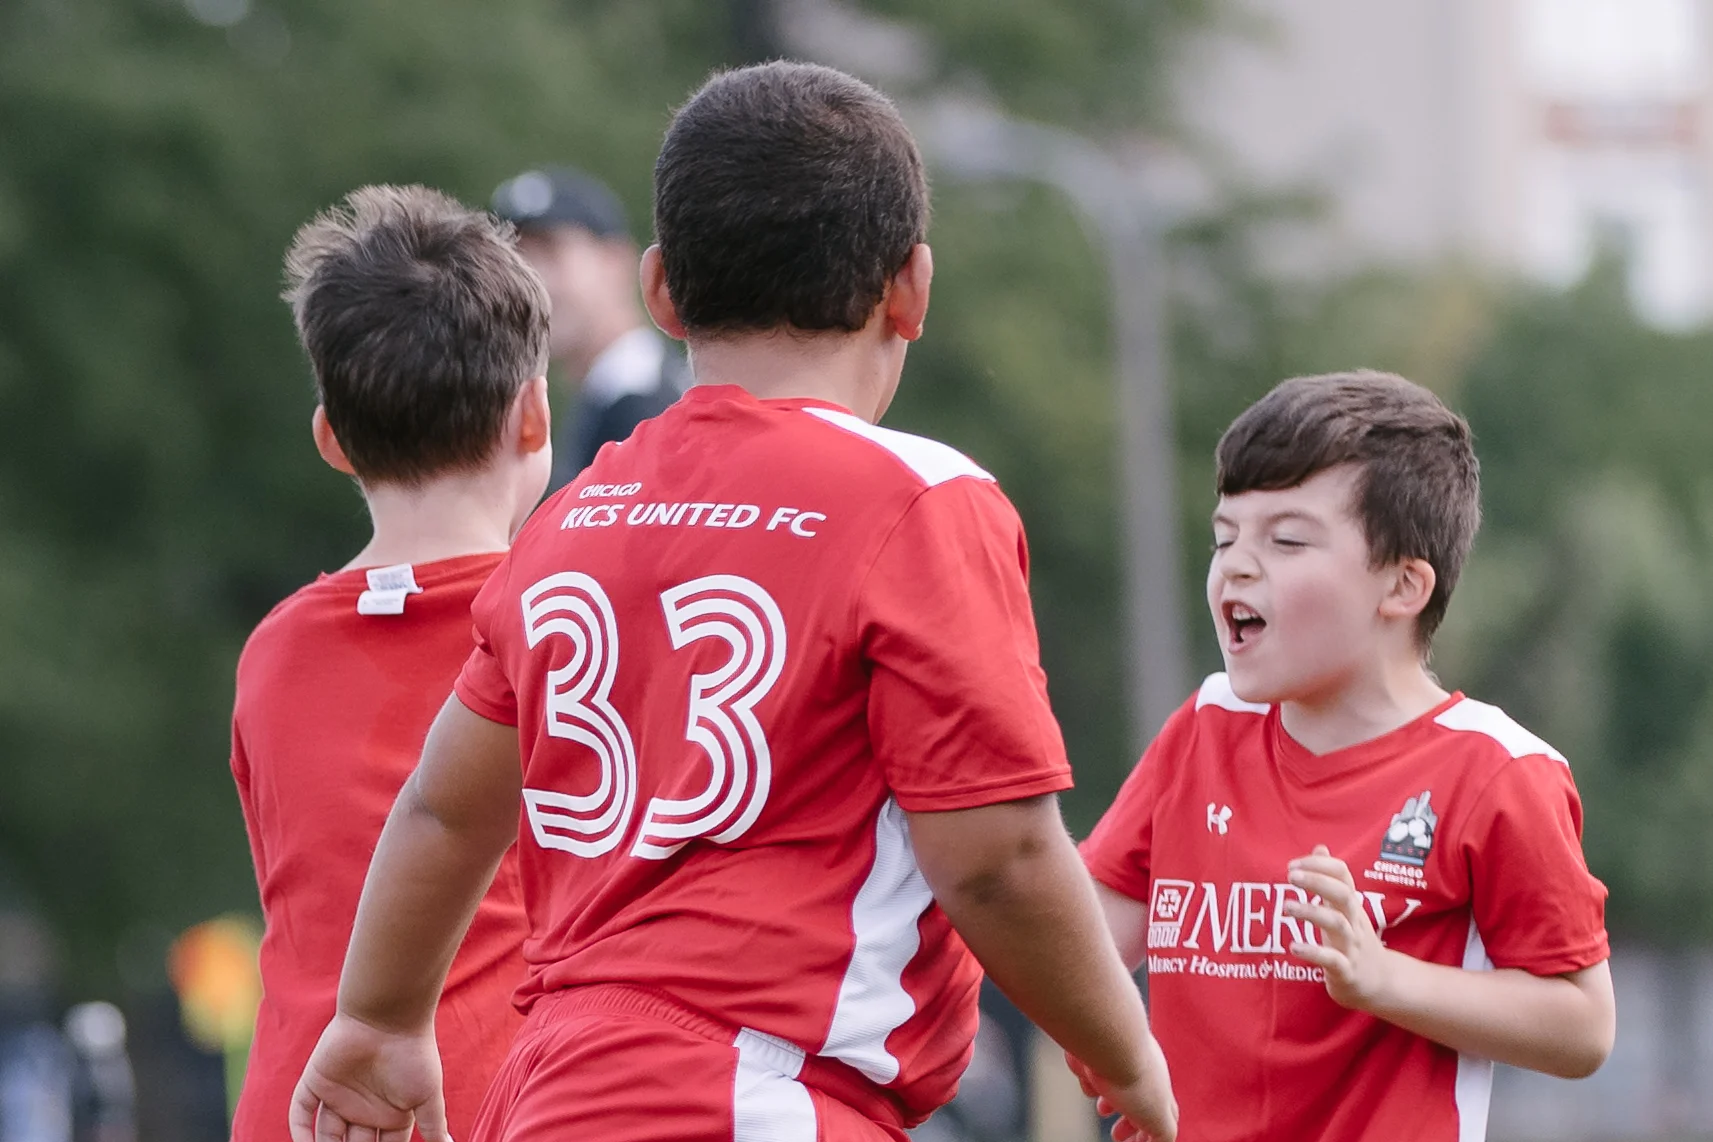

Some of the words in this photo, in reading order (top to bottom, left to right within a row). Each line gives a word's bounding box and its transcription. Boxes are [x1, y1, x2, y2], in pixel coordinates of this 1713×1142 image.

[579, 482, 642, 499] CHICAGO
[560, 504, 625, 530] KICS
[626, 503, 760, 528] UNITED
[766, 507, 827, 538] FC
[521, 571, 787, 860] 33
[1373, 861, 1424, 879] CHICAGO
